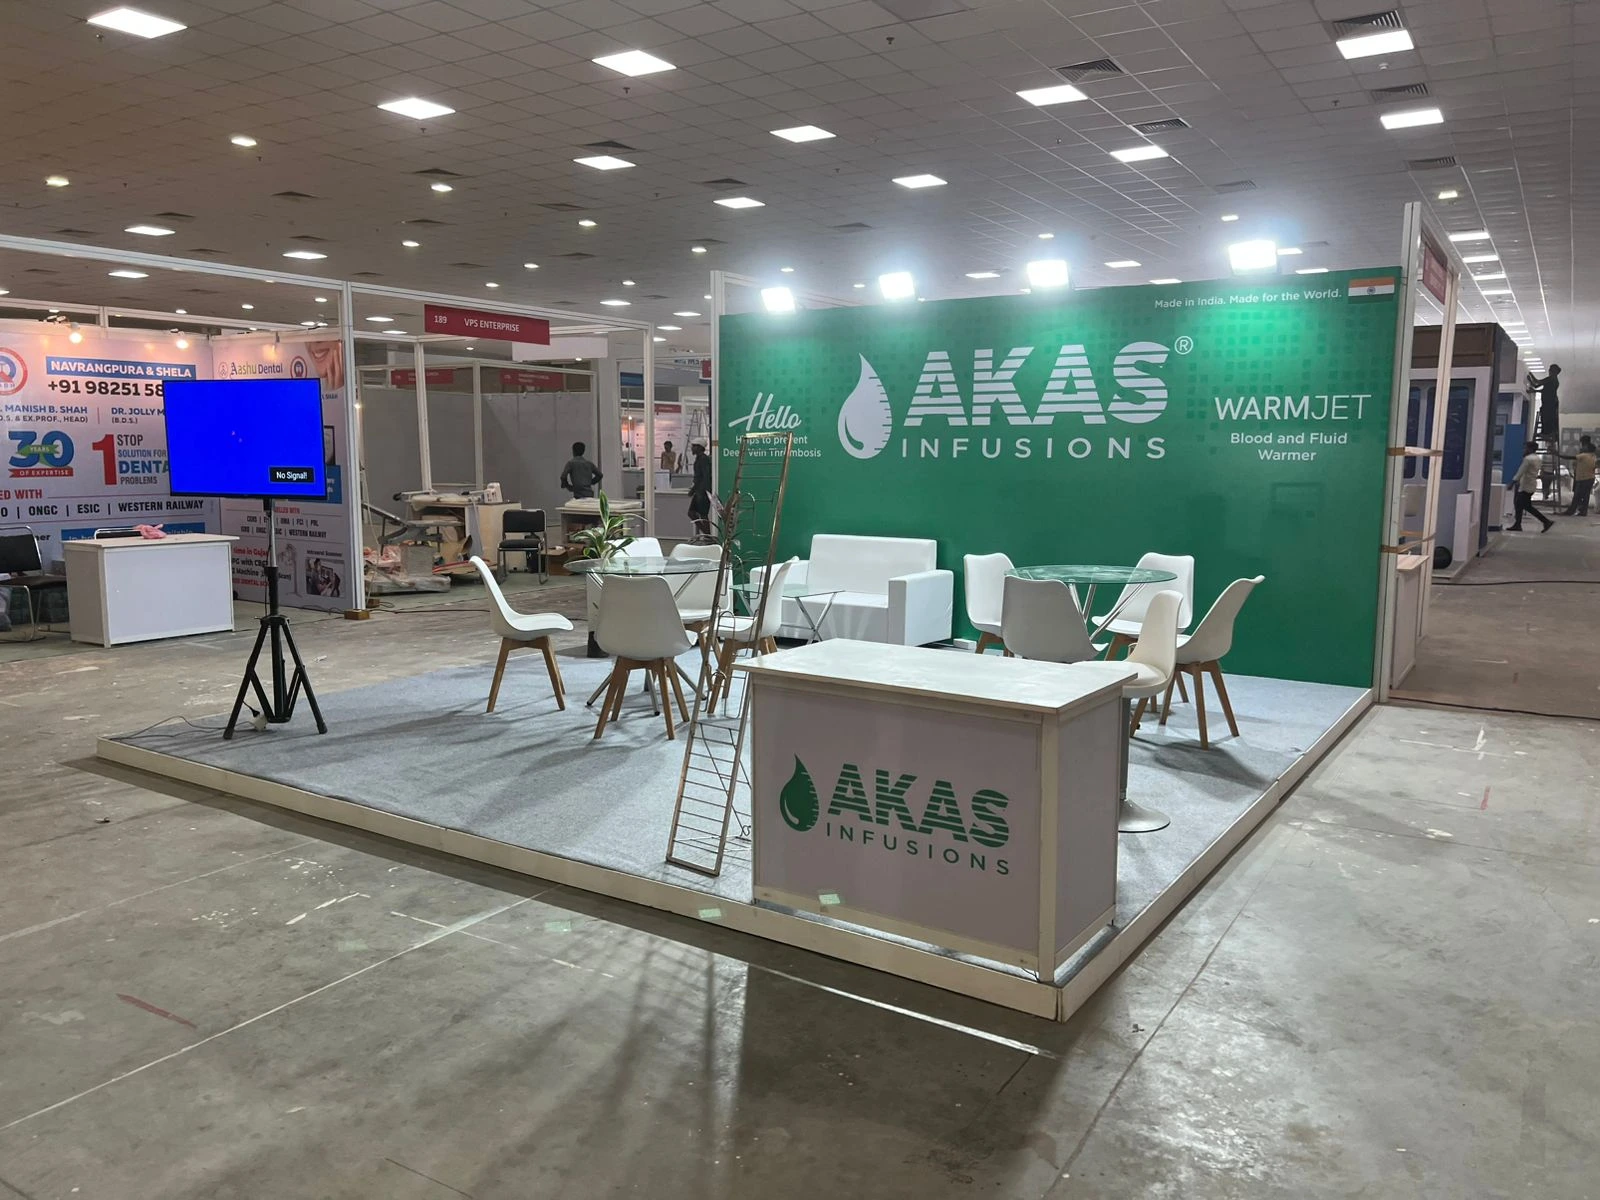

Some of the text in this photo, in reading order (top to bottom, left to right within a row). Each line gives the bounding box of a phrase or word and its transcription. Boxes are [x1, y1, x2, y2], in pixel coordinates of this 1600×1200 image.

[1155, 288, 1342, 308] Made in India. Made for the World.
[434, 315, 520, 332] 189 VPS ENTERPRISE
[50, 360, 192, 378] NAVRANGPURA & SHELA
[258, 363, 283, 374] Dental
[48, 380, 80, 394] +91
[85, 380, 141, 396] 98251
[903, 341, 1170, 426] AKAS
[5, 404, 88, 414] MANISH B. SHAH
[111, 407, 126, 415] DR.
[129, 408, 156, 416] JOLLY
[728, 392, 802, 432] Hello
[1214, 394, 1372, 420] WARMJET
[64, 416, 88, 424] HEAD)
[117, 434, 144, 446] STOP
[735, 436, 760, 444] Hlps
[773, 436, 808, 446] preent
[1230, 432, 1348, 444] Blood and Fluid
[8, 430, 74, 468] 30
[118, 449, 167, 458] SOLUTION FOR
[723, 448, 743, 458] Dee
[902, 437, 1166, 458] INFUSIONS
[92, 434, 118, 486] 1
[1258, 449, 1317, 461] Warmer
[119, 460, 170, 474] DENTA
[120, 476, 158, 485] PROBLEMS
[286, 472, 308, 480] Signal!
[14, 490, 42, 500] WITH
[28, 505, 58, 516] ONGC
[77, 504, 100, 514] ESIC
[118, 502, 163, 512] WESTERN
[166, 500, 204, 510] RAILWAY
[828, 763, 1010, 848] AKAS
[826, 822, 1010, 875] INFUSIONS
